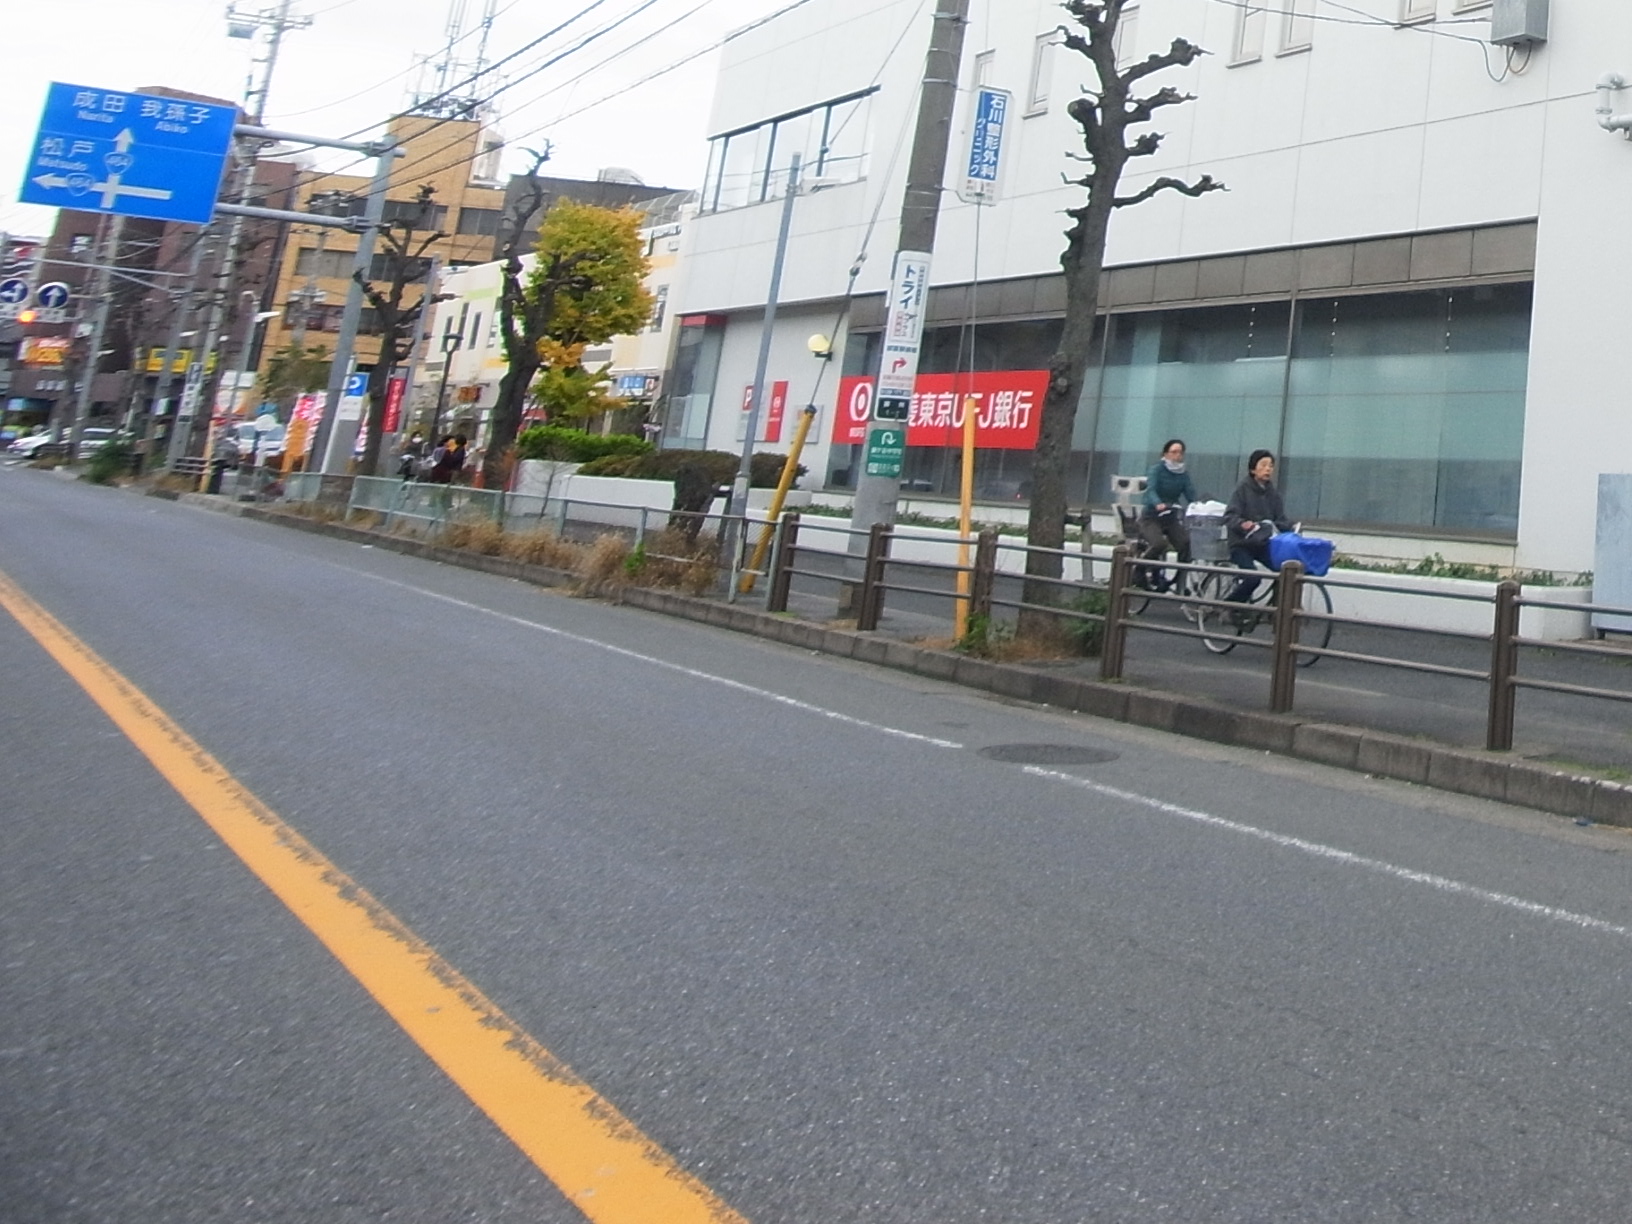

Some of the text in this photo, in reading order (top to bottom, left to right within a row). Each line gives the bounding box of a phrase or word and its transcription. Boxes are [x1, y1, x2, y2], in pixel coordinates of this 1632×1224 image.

[72, 91, 126, 113] 成田
[140, 100, 211, 124] 我孫子
[40, 137, 95, 158] 松戸
[970, 117, 987, 176] クリニック
[900, 264, 916, 309] トライ
[908, 390, 1034, 429] 菱東京UJ銀行
